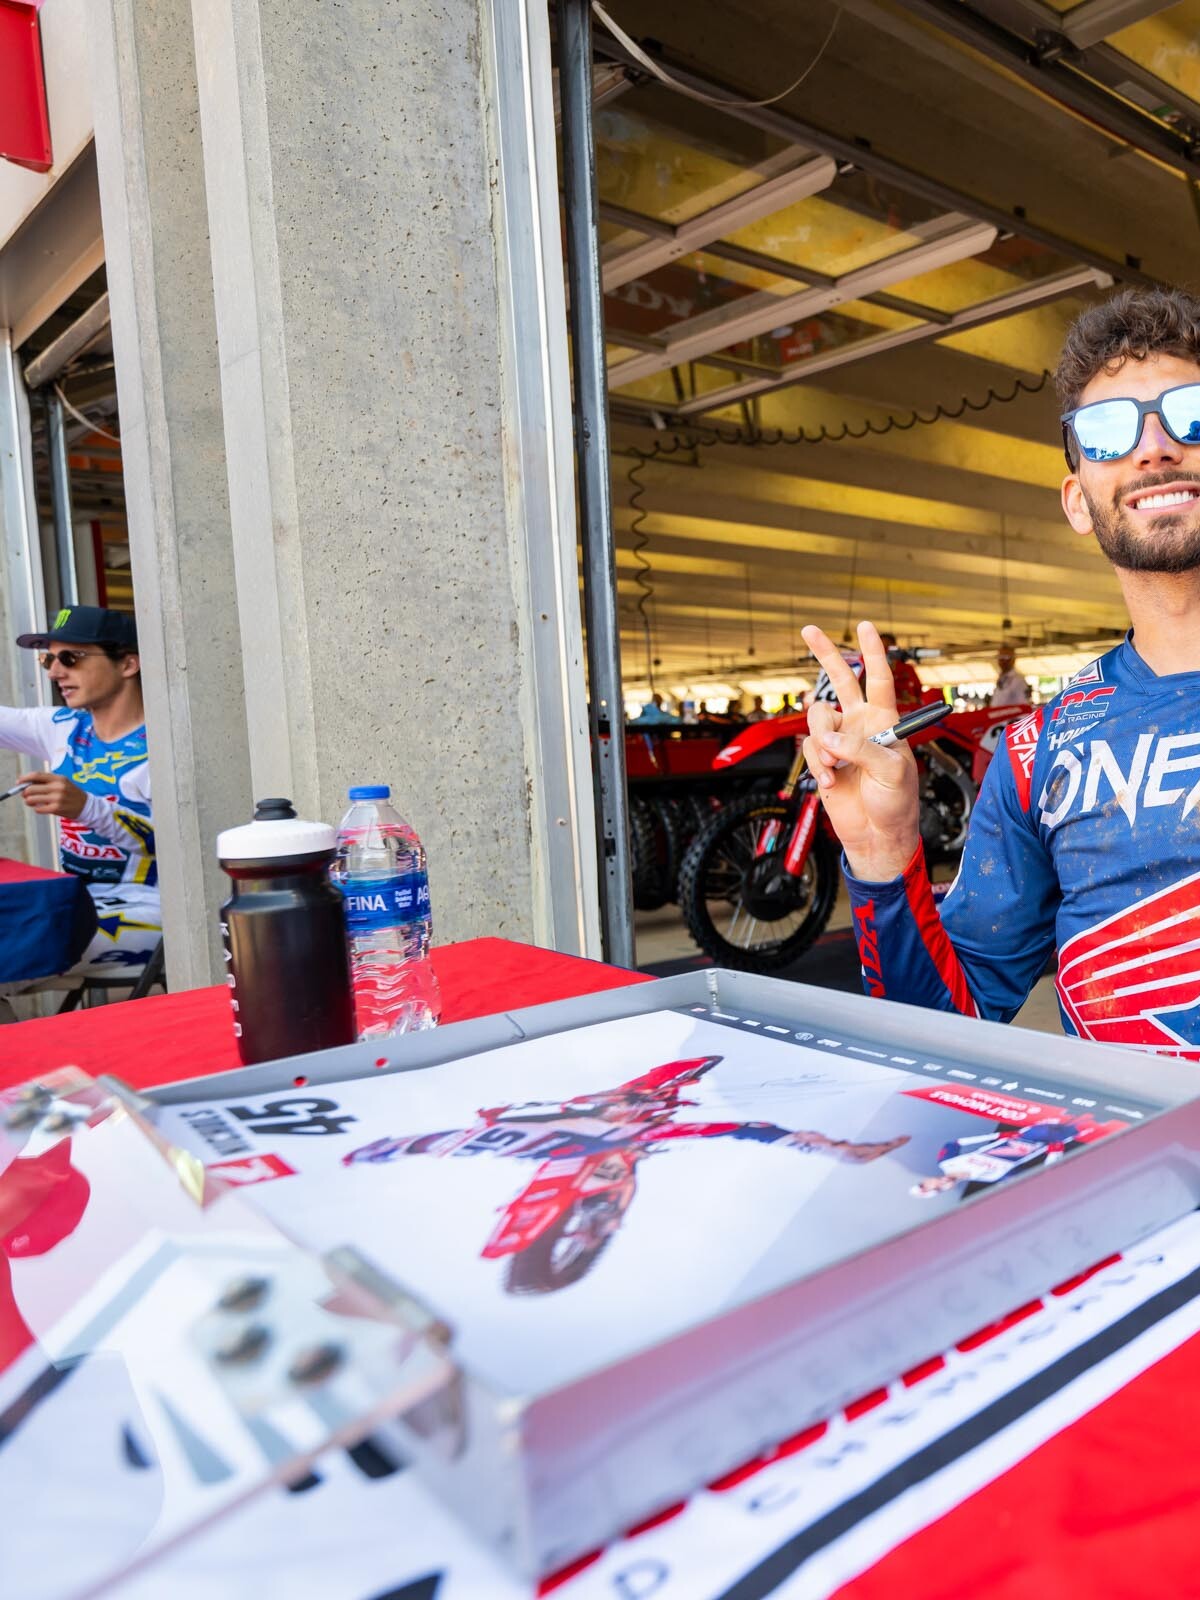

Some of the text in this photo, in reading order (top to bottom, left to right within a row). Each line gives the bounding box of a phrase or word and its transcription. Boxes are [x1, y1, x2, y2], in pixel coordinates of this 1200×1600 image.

[344, 894, 390, 912] FINA
[854, 899, 887, 998] NDA
[226, 1097, 359, 1136] 45
